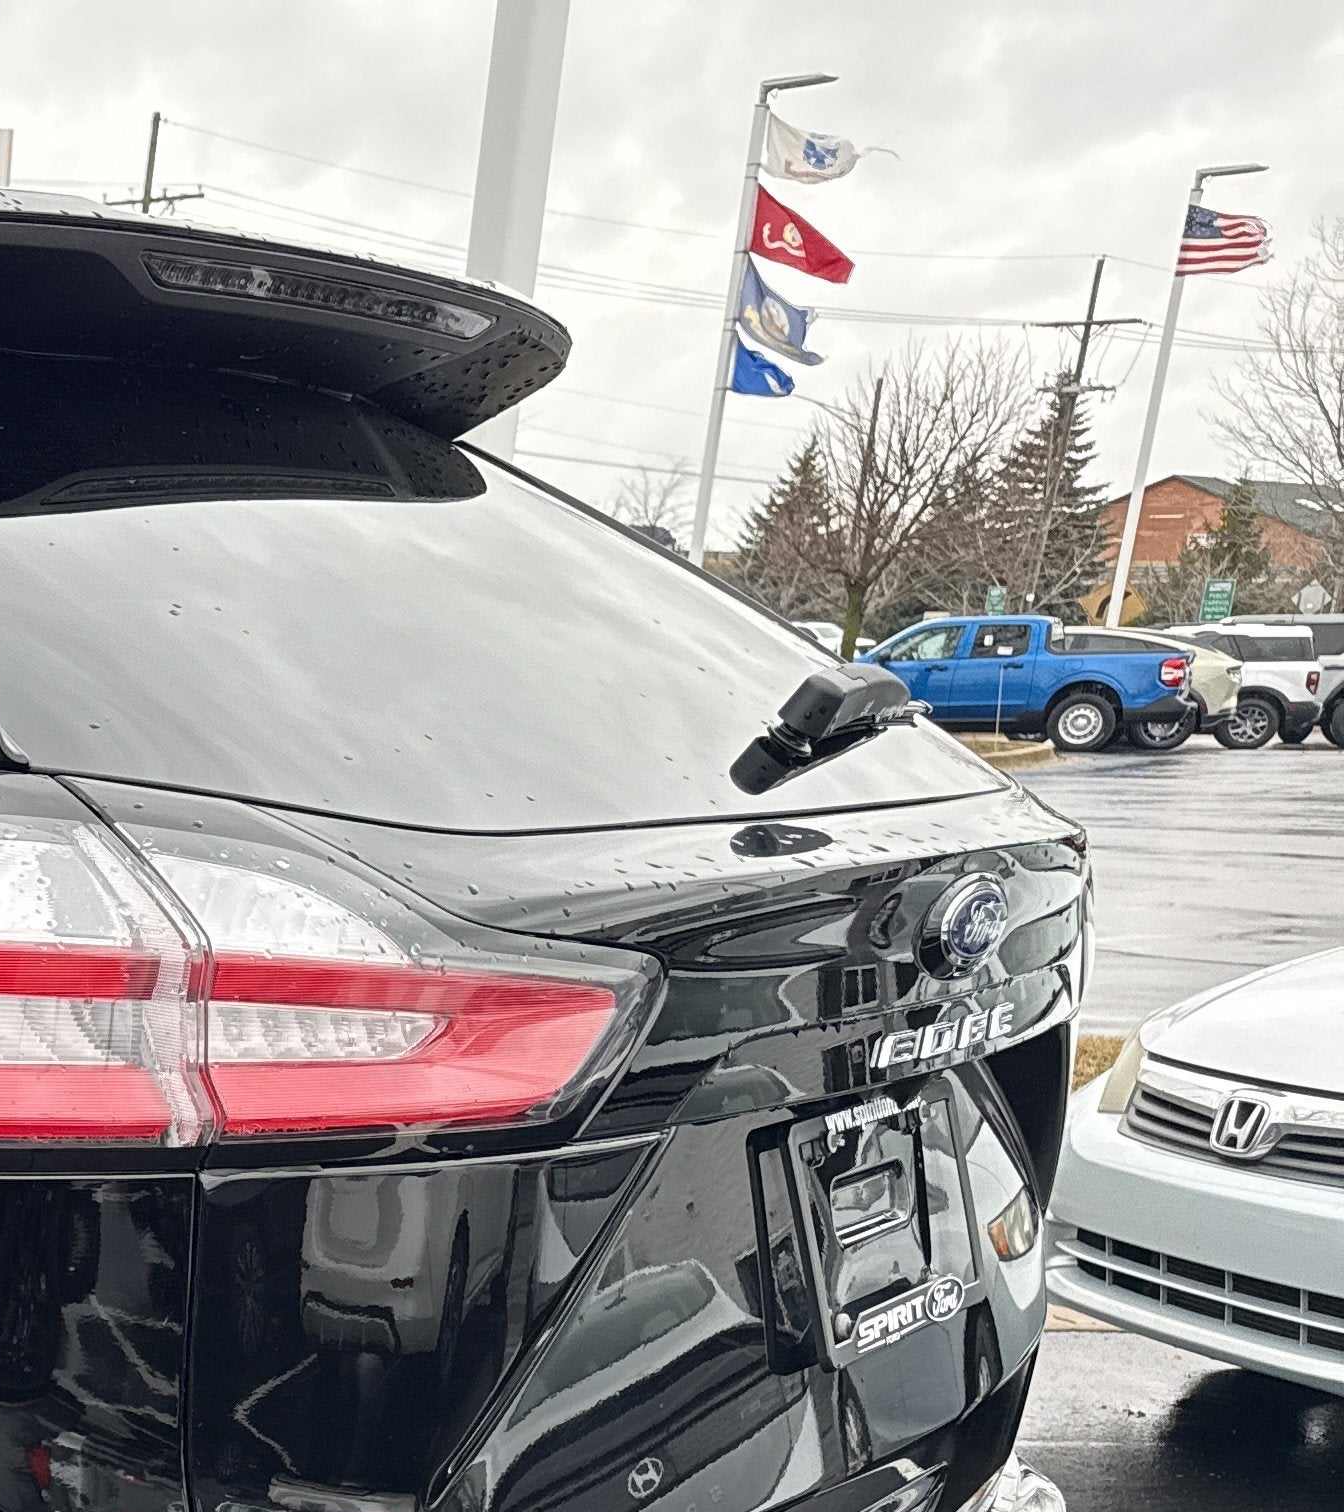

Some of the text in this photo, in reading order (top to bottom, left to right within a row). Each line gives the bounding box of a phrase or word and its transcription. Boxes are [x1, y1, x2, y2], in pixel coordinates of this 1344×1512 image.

[960, 897, 1010, 948] Ford
[856, 1279, 962, 1348] SPIRIT Ford
